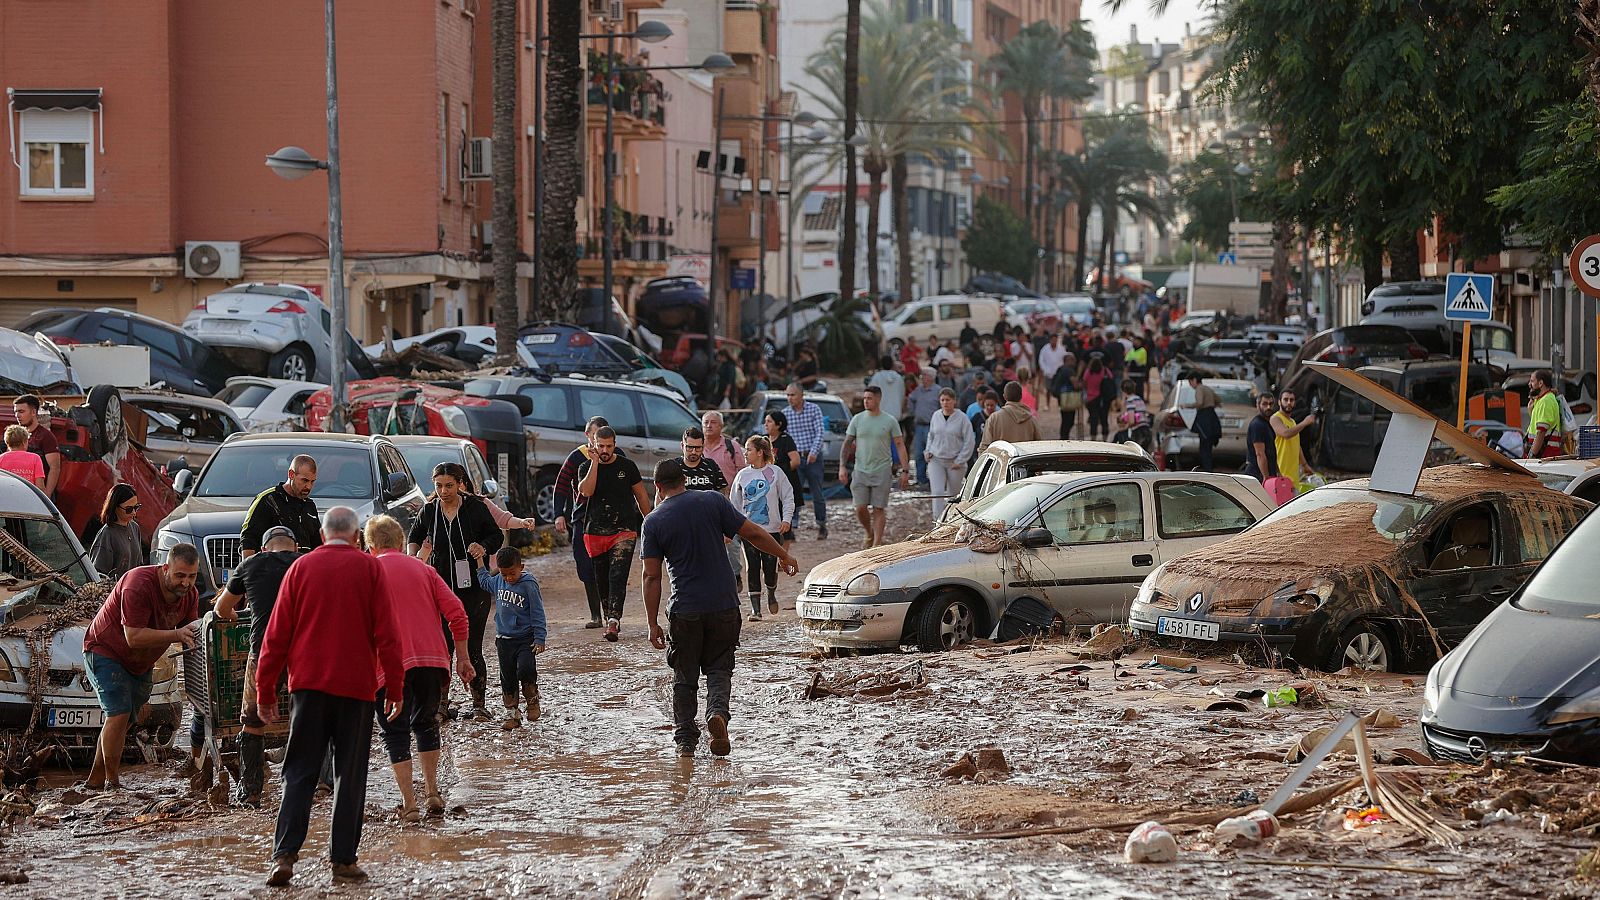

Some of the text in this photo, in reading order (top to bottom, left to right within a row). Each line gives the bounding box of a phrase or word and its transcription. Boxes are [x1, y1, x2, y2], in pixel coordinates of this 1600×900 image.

[1585, 256, 1600, 277] 3
[685, 476, 709, 485] didas
[1165, 620, 1213, 638] 4581 FFL
[58, 711, 91, 725] 9051
